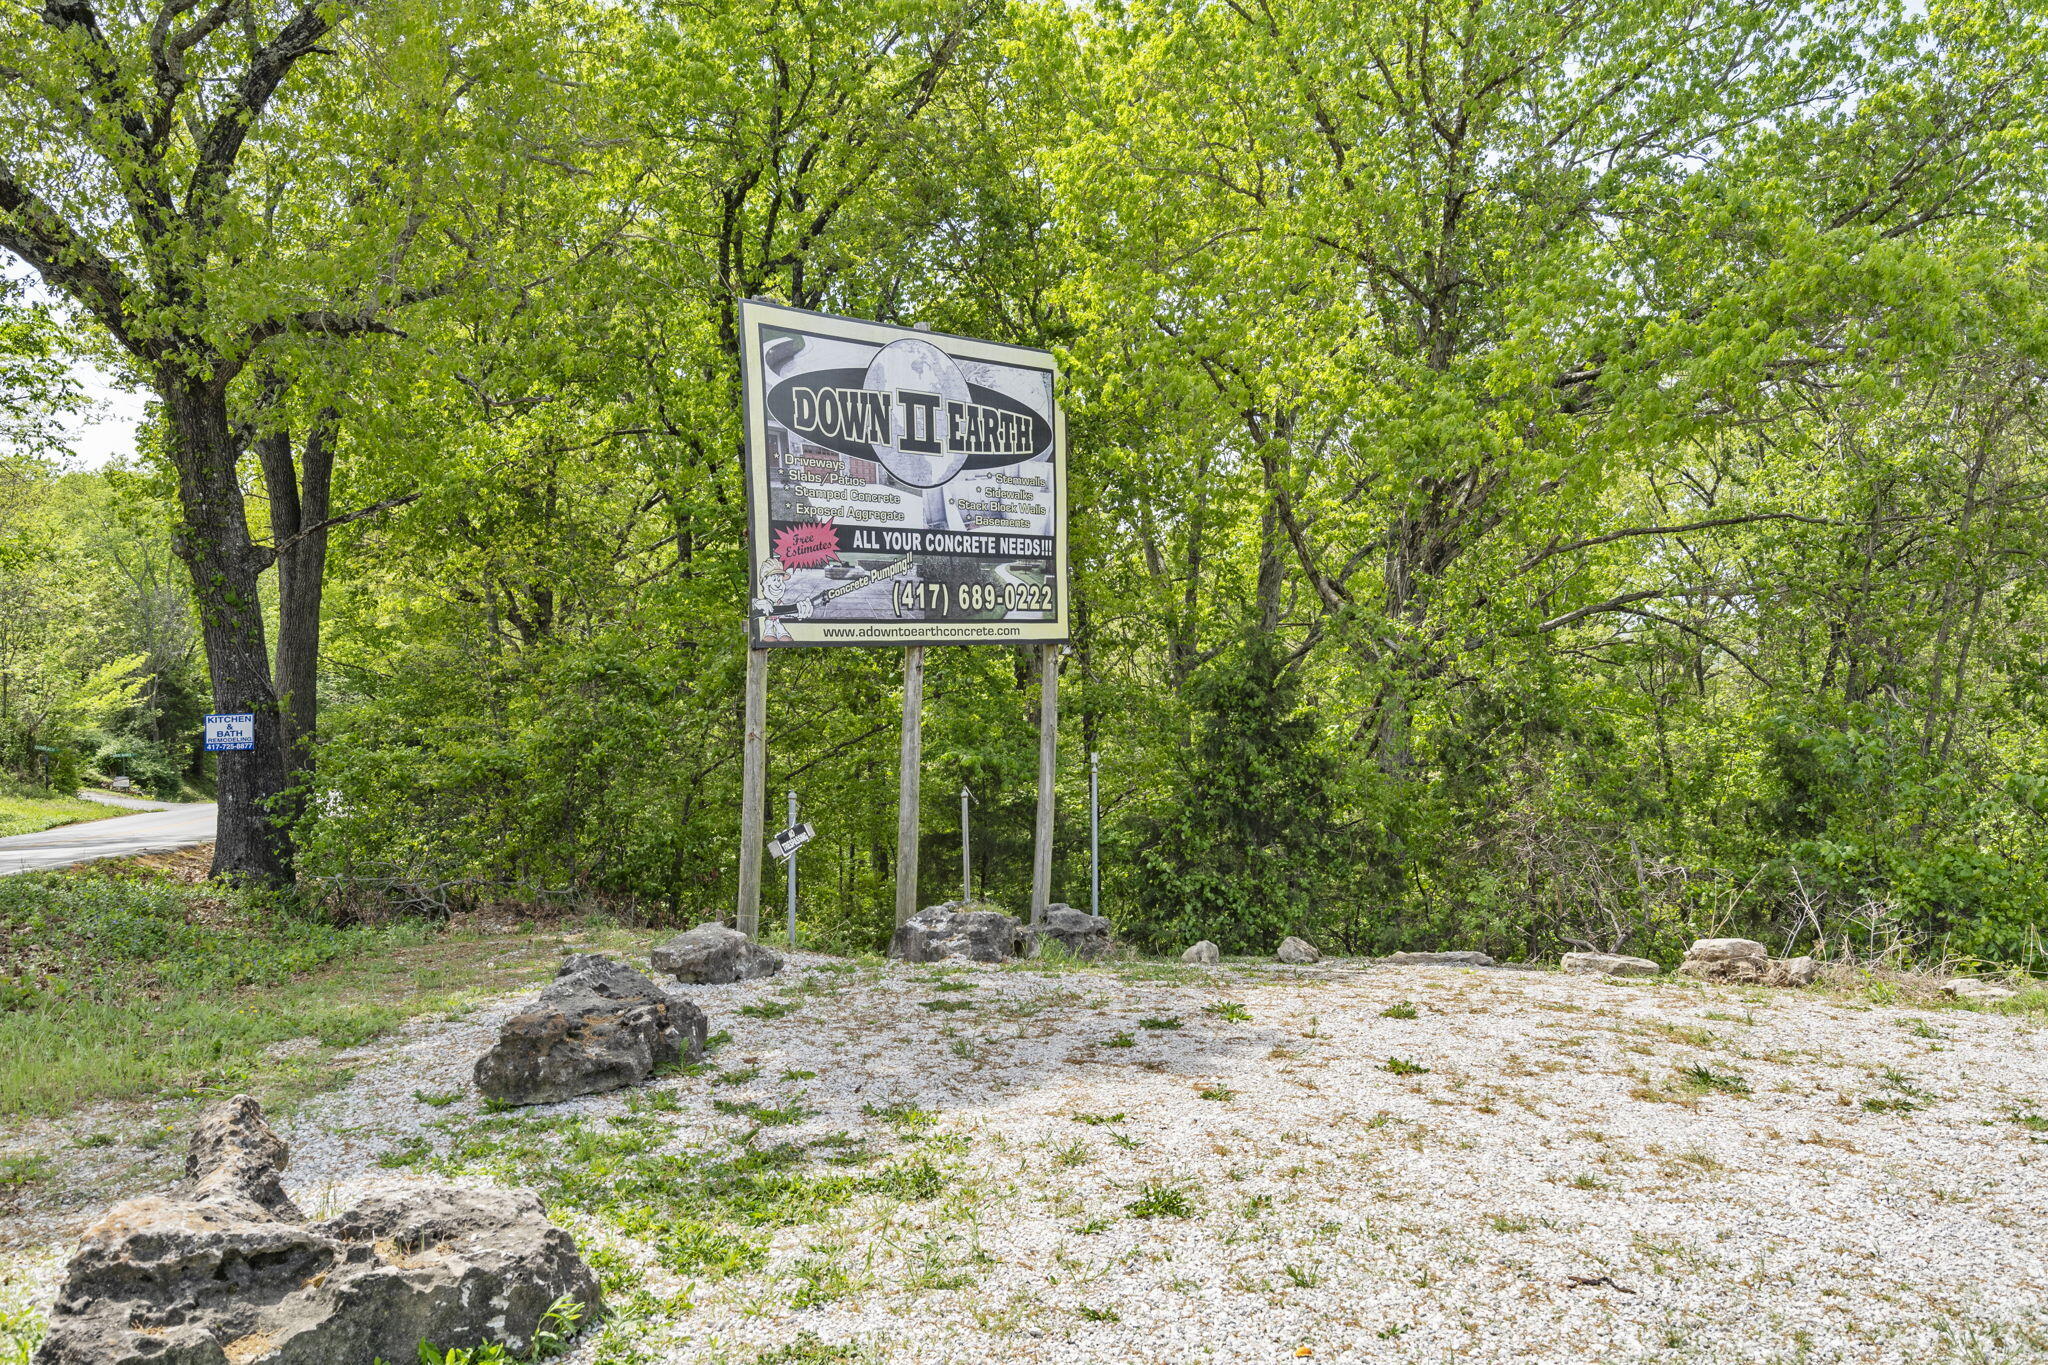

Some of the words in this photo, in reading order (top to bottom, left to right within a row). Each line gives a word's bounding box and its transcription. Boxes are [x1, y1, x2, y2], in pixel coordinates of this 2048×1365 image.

[792, 386, 893, 447] DOWN
[946, 399, 1034, 455] EARTH
[784, 453, 846, 471] Driveways
[788, 469, 867, 487] Slabs/Patios
[995, 473, 1047, 487] Stemwalls
[794, 485, 848, 502] Stamped
[849, 490, 902, 504] Concrete
[984, 487, 1034, 501] Sidewalks
[796, 502, 845, 517] Exposed
[846, 506, 905, 523] Aggregate
[957, 499, 988, 512] Stack
[989, 501, 1018, 513] Block
[1018, 503, 1046, 515] Walls
[974, 515, 1031, 528] Basements
[792, 534, 814, 546] Free
[853, 530, 880, 549] ALL
[882, 531, 922, 551] YOUR
[925, 533, 996, 554] CONCRETE
[1000, 537, 1053, 556] NEEDS!!!
[785, 541, 832, 558] Estimates
[827, 576, 870, 599] Concrete
[870, 551, 913, 583] Pumping!!
[892, 581, 949, 617] (417)
[958, 582, 1053, 611] 689-0222
[823, 626, 1021, 638] www.adowntoearthconcrete.com
